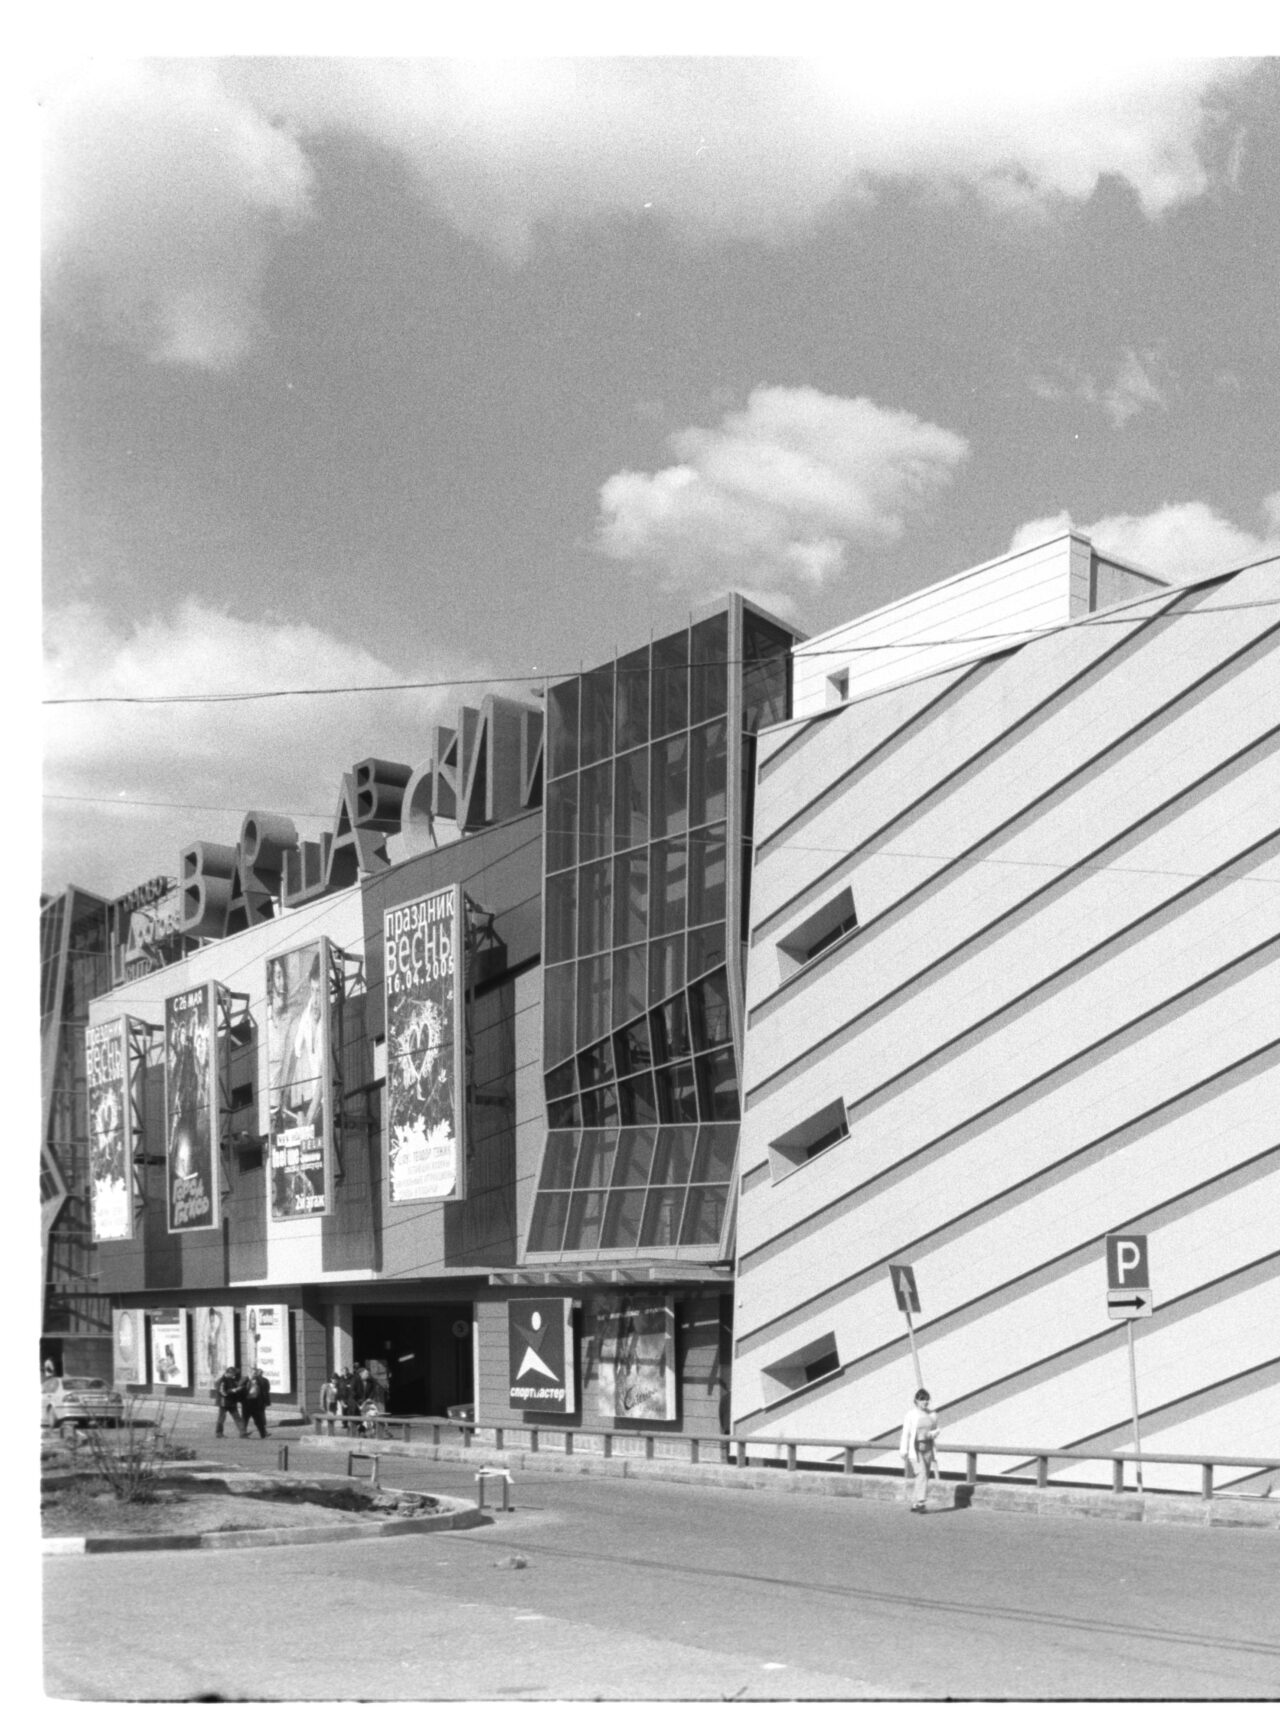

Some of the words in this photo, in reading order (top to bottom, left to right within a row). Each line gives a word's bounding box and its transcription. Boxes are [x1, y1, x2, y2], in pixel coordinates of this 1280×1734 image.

[386, 891, 454, 943] праздник
[388, 955, 454, 995] 16.04.2005
[1117, 1241, 1140, 1284] P
